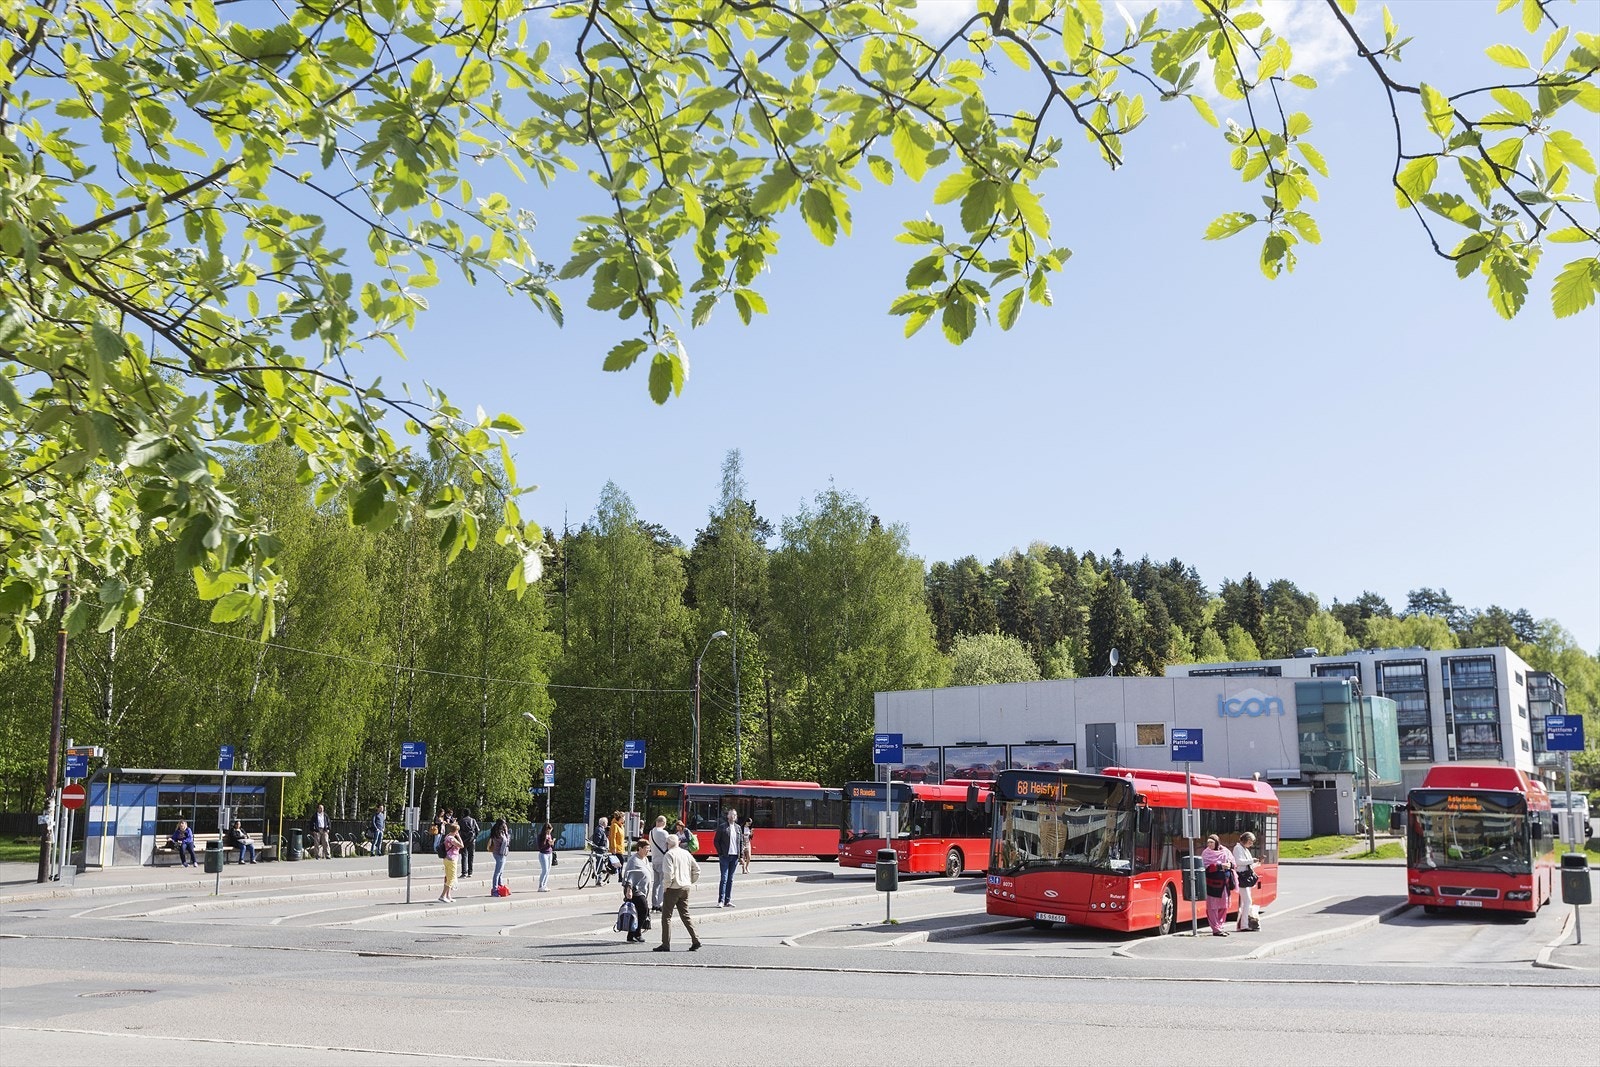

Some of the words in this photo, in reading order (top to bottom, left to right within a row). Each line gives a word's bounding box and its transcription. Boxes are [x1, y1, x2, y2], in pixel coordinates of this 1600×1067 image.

[1217, 693, 1285, 718] icon
[853, 787, 859, 797] 63
[1017, 780, 1028, 795] 68
[1062, 783, 1068, 796] T
